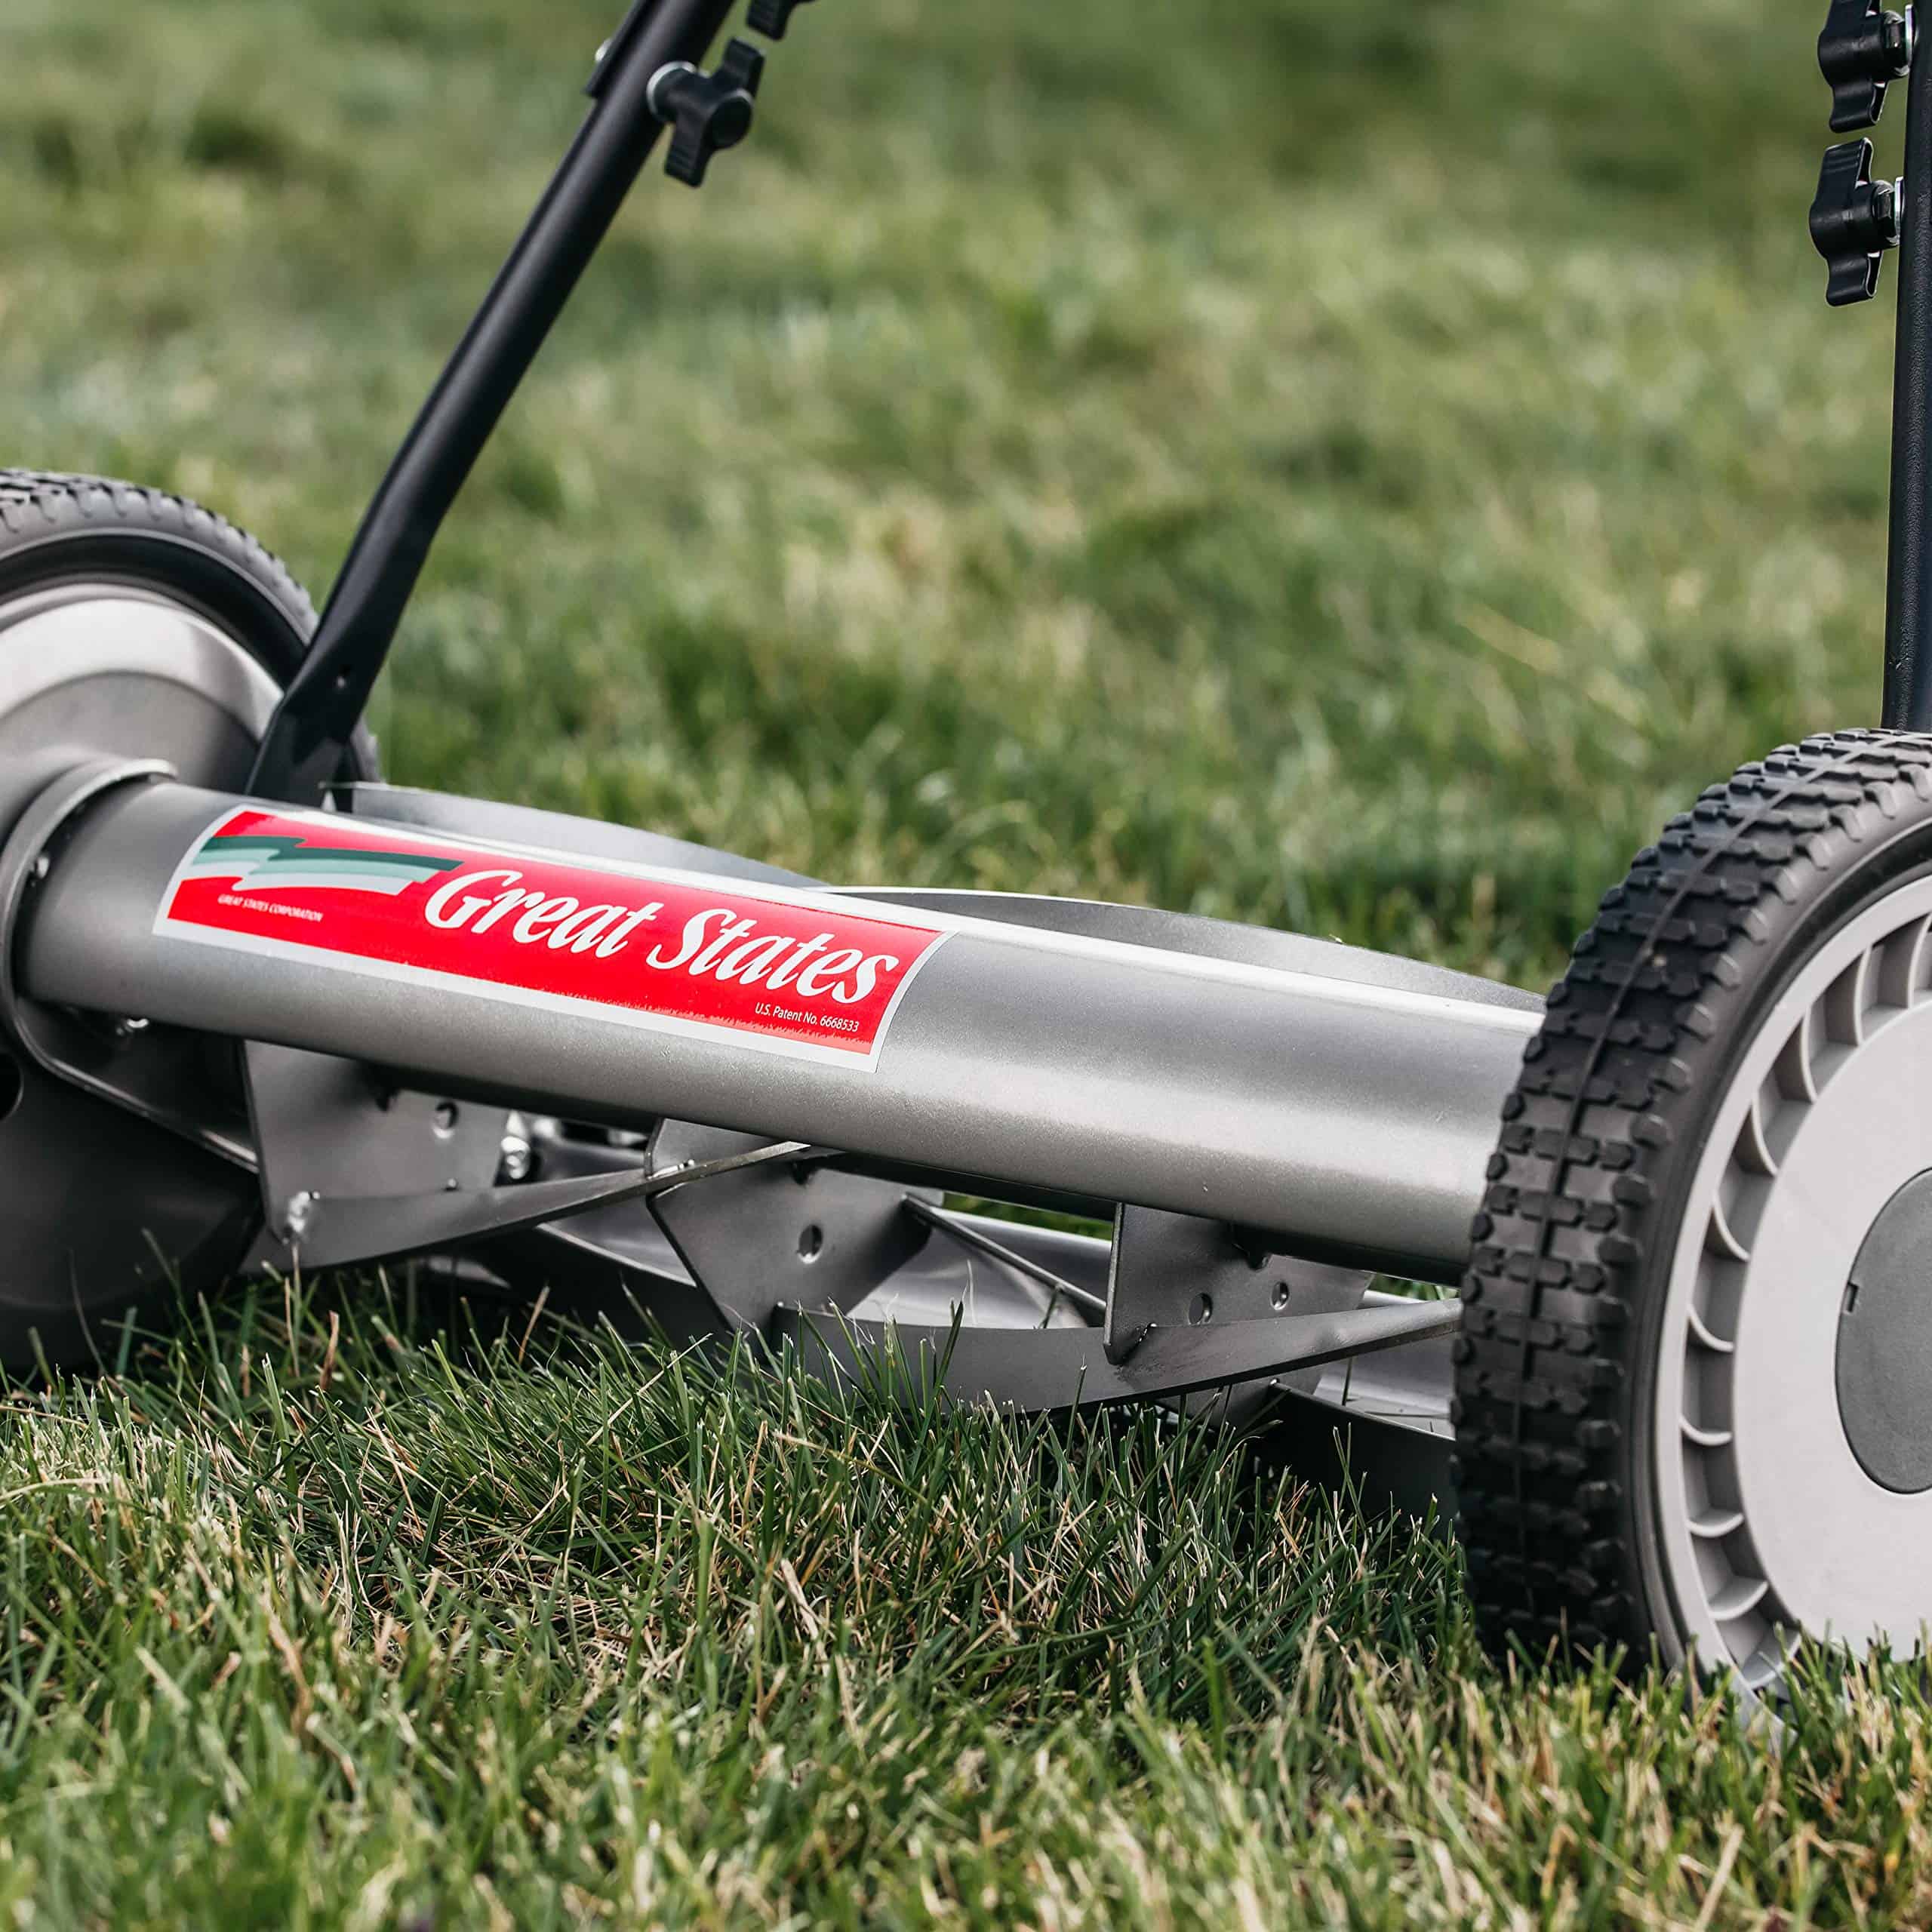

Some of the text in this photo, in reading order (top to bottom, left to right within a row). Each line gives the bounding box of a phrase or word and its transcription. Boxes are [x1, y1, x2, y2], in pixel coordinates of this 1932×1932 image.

[217, 894, 324, 922] GREAT STATES CORPORATION
[424, 869, 900, 1004] Great States
[755, 1001, 859, 1032] U.S. Patent No. 6668533
